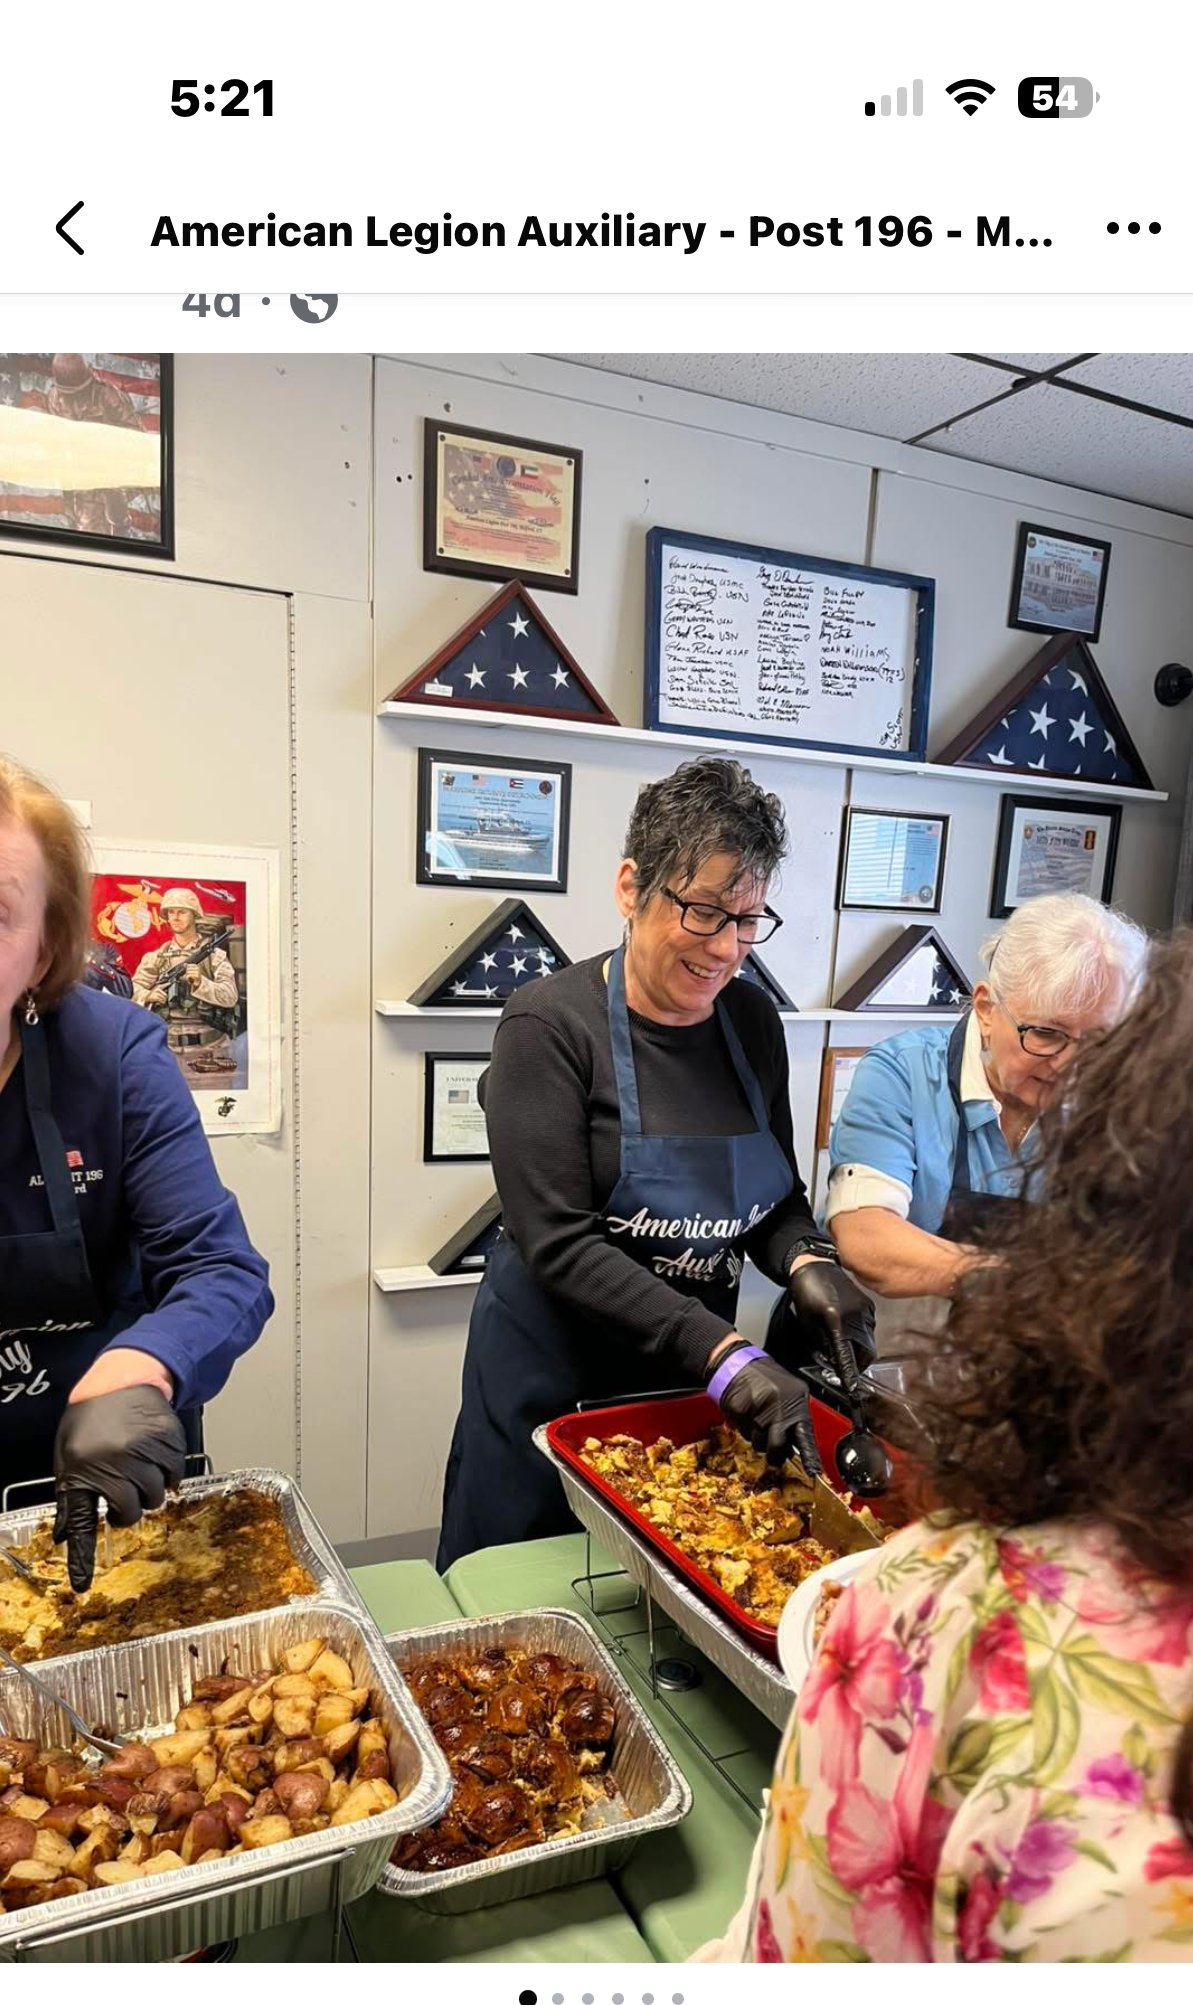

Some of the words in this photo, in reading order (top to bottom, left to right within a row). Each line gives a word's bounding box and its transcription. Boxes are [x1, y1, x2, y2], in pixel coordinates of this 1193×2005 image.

[86, 1169, 104, 1182] 196
[74, 1183, 88, 1194] rd
[606, 1206, 743, 1239] American
